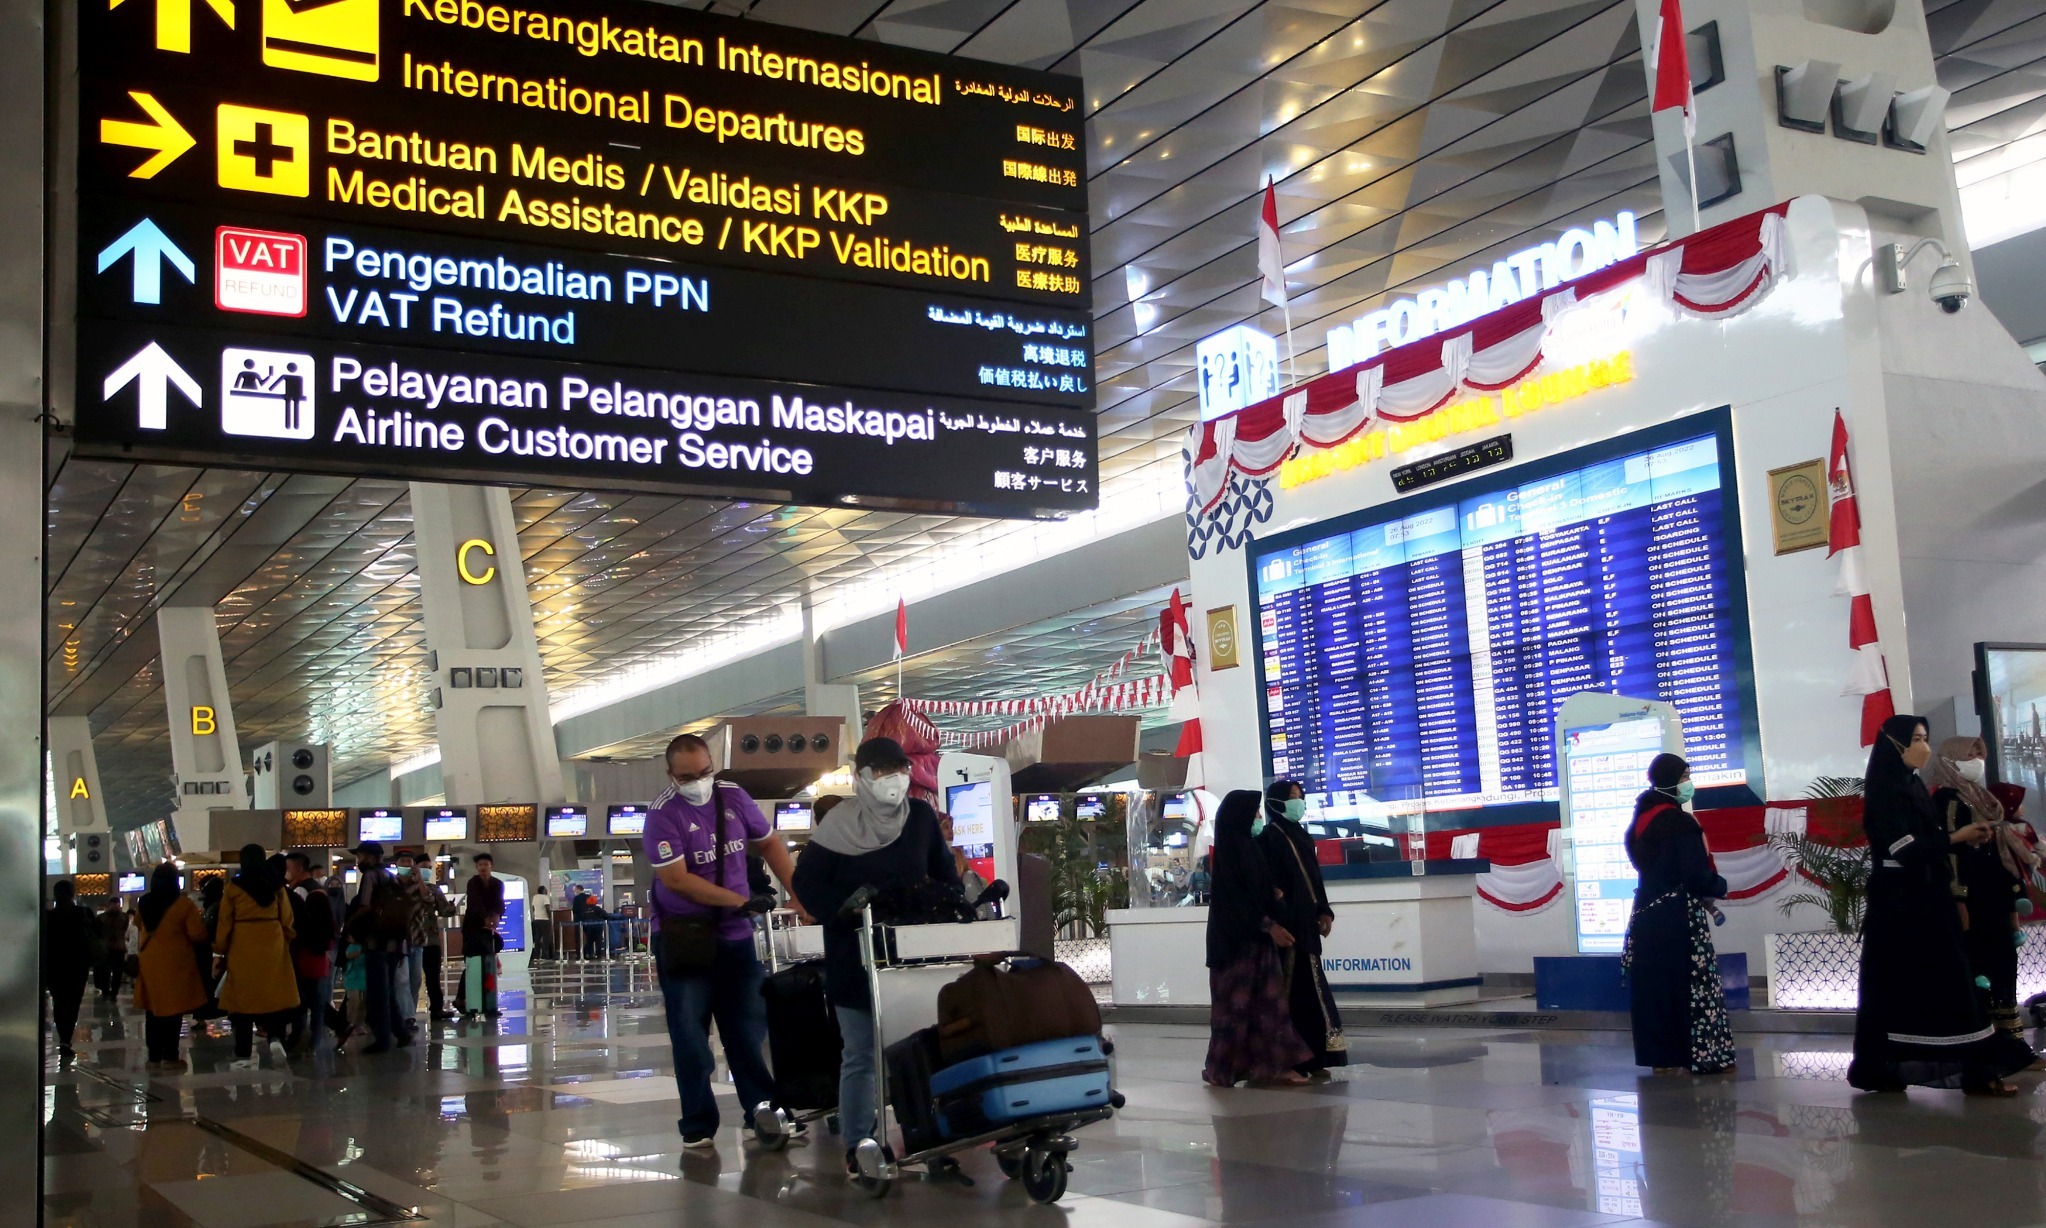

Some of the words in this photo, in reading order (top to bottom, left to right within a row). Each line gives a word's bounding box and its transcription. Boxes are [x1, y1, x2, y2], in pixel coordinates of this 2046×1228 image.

[404, 0, 703, 66] Keberangkatan
[719, 37, 940, 105] Internasional
[404, 53, 649, 123] International
[665, 94, 864, 155] Departures
[1016, 125, 1076, 150] 国际出发
[327, 118, 496, 173] Bantuan
[512, 144, 625, 190] Medis
[640, 164, 654, 196] /
[663, 166, 800, 215] Validasi
[813, 186, 888, 225] KKP
[1003, 160, 1077, 187] 国際線出発
[328, 166, 484, 219] Medical
[498, 189, 704, 245] Assistance
[718, 217, 732, 250] /
[743, 220, 820, 259] KKP
[829, 231, 989, 282] Validation
[229, 237, 294, 269] VAT
[1016, 243, 1079, 268] 医疗服务
[325, 236, 611, 302] Pengembalian
[625, 270, 708, 312] PPN
[225, 278, 297, 299] REFUND
[1326, 211, 1637, 375] INFORMATION
[326, 285, 418, 328] VAT
[432, 296, 574, 344] Refund
[332, 357, 547, 409] Pelayanan
[561, 376, 760, 431] Pelanggan
[771, 394, 935, 445] Maskapai
[334, 406, 464, 450] Airline
[477, 416, 668, 464] Customer
[678, 430, 813, 475] Service
[1023, 446, 1087, 469] 客户服务
[994, 470, 1089, 493] 顧客サービス
[1506, 477, 1564, 503] General
[1507, 490, 1562, 513] Check-in
[1569, 484, 1627, 507] Domestic
[1650, 501, 1673, 512] LAST
[1674, 495, 1697, 507] CALL
[1651, 512, 1674, 523] LAST
[1675, 506, 1698, 517] CALL
[1651, 521, 1674, 532] LAST
[1675, 515, 1699, 527] CALL
[1646, 544, 1660, 553] ON
[1661, 533, 1708, 550] SCHEDULE
[1653, 525, 1699, 542] BOARDING
[1292, 540, 1329, 557] General
[1424, 555, 1438, 564] CALL
[457, 539, 496, 585] C
[1425, 573, 1439, 581] CALL
[1649, 582, 1663, 590] ON
[1664, 572, 1711, 587] SCHEDULE
[1652, 620, 1666, 628] ON
[1667, 611, 1714, 626] SCHEDULE
[1656, 660, 1670, 668] ON
[1670, 652, 1718, 666] SCHEDULE
[192, 706, 216, 735] B
[70, 777, 90, 799] A
[967, 823, 984, 835] HERE
[1323, 957, 1411, 971] INFORMATION
[1379, 1012, 1428, 1024] PLEASE
[1431, 1013, 1477, 1025] WATCH
[1479, 1014, 1519, 1025] YOUR
[1521, 1014, 1558, 1026] STEP
